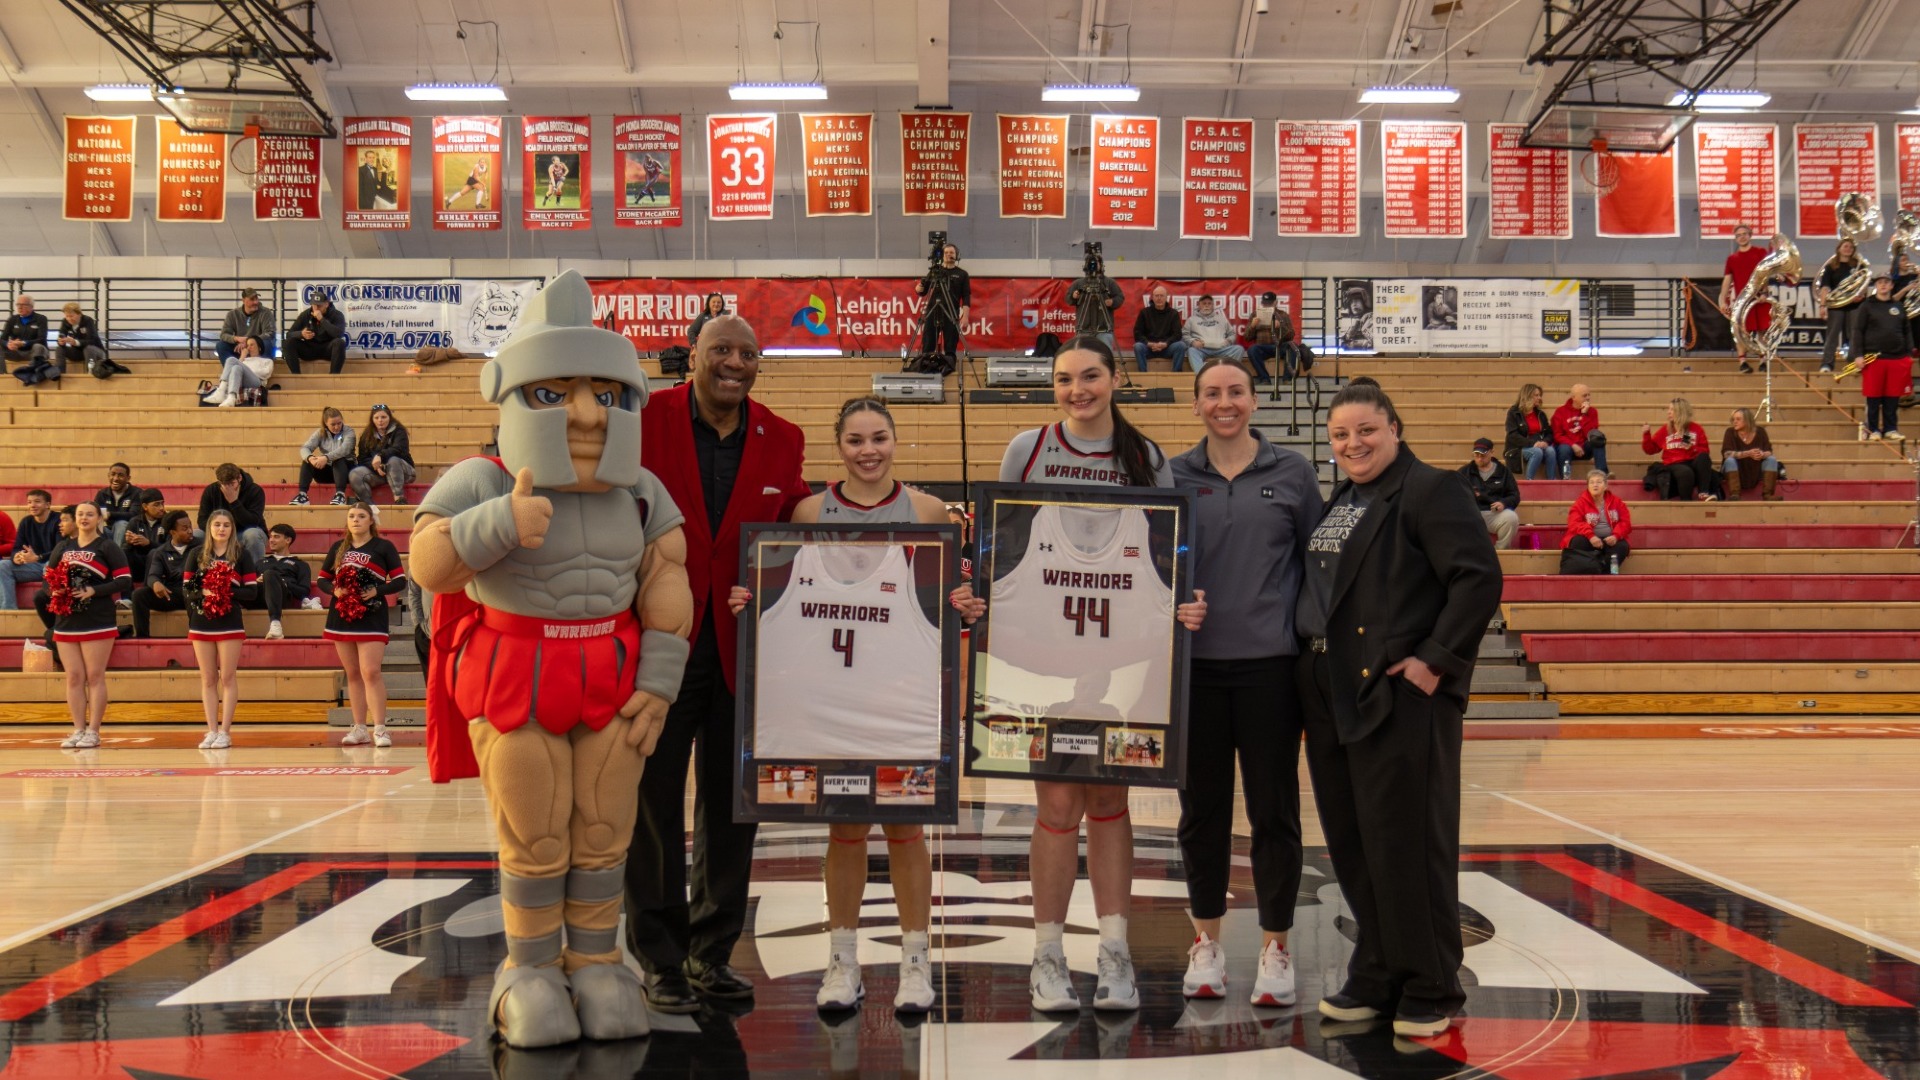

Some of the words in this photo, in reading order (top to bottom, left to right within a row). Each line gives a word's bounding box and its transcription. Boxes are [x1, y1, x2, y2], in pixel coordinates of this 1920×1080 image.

[87, 124, 112, 135] NCAA
[904, 129, 945, 139] EASTERN
[950, 130, 967, 139] DIV.
[537, 135, 553, 143] FIELD
[628, 133, 644, 141] FIELD
[644, 133, 666, 141] HOCKEY
[811, 132, 863, 142] CHAMPIONS
[1007, 134, 1058, 144] CHAMPIONS
[77, 138, 123, 149] NATIONAL
[910, 141, 961, 150] CHAMPIONS
[1098, 137, 1151, 148] CHAMPIONS
[1304, 138, 1321, 146] POINT
[1322, 138, 1351, 146] SCORERS
[169, 142, 216, 154] NATIONAL
[826, 145, 850, 153] MEN'S
[1016, 147, 1050, 155] WOMEN'S
[1190, 142, 1246, 152] CHAMPIONS
[68, 153, 132, 164] SEMI-FINALISTS
[919, 152, 952, 160] WOMEN'S
[1112, 151, 1136, 159] MEN'S
[1205, 154, 1230, 164] MEN'S
[162, 158, 221, 170] RUNNERS-UP
[813, 157, 862, 165] BASKETBALL
[1008, 158, 1057, 167] BASKETBALL
[264, 165, 309, 173] NATIONAL
[721, 147, 765, 186] 33
[911, 163, 959, 171] BASKETBALL
[1099, 162, 1148, 172] BASKETBALL
[87, 167, 112, 176] MEN'S
[807, 168, 828, 176] NCAA
[833, 167, 869, 175] REGIONAL
[1002, 170, 1023, 178] NCAA
[1028, 170, 1064, 178] REGIONAL
[1190, 168, 1243, 178] BASKETBALL
[259, 175, 316, 184] SEMI-FINALIST
[905, 173, 926, 181] NCAA
[931, 172, 965, 181] REGIONAL
[1113, 175, 1134, 184] NCAA
[83, 180, 115, 189] SOCCER
[819, 178, 858, 187] FINALISTS
[905, 182, 965, 190] SEMI-FINALISTS
[1002, 180, 1064, 189] SEMI-FINALISTS
[1186, 181, 1206, 191] NCAA
[1209, 181, 1248, 191] REGIONAL
[263, 188, 312, 197] FOOTBALL
[741, 192, 765, 200] POINTS
[1099, 187, 1148, 197] TOURNAMENT
[276, 199, 298, 207] 11-3
[1195, 195, 1237, 205] FINALISTS
[85, 205, 112, 213] 2000
[178, 203, 203, 212] 2001
[735, 204, 771, 212] REBOUNDS
[829, 201, 850, 209] 1990
[925, 202, 946, 210] 1994
[1023, 203, 1043, 211] 1995
[271, 208, 304, 217] 2005
[1112, 213, 1133, 222] 2012
[1205, 222, 1227, 232] 2014
[303, 284, 339, 305] GAK
[341, 284, 461, 304] CONSTRUCTION
[1022, 298, 1039, 306] part
[1376, 296, 1387, 304] IS
[592, 294, 738, 320] WARRIOS
[837, 296, 904, 318] Lehigh
[837, 317, 902, 335] Health
[1042, 323, 1076, 332] Health
[1382, 336, 1416, 344] GREAT.
[1045, 465, 1129, 486] WARRIORS
[1308, 538, 1341, 552] SPORTS.
[1043, 569, 1132, 590] WARRIORS
[801, 602, 890, 623] WARRIORS
[1063, 595, 1109, 638] 44
[544, 620, 615, 639] WARRIORS
[832, 628, 854, 667] 4
[825, 778, 845, 786] AVERY
[847, 778, 867, 786] WHITE
